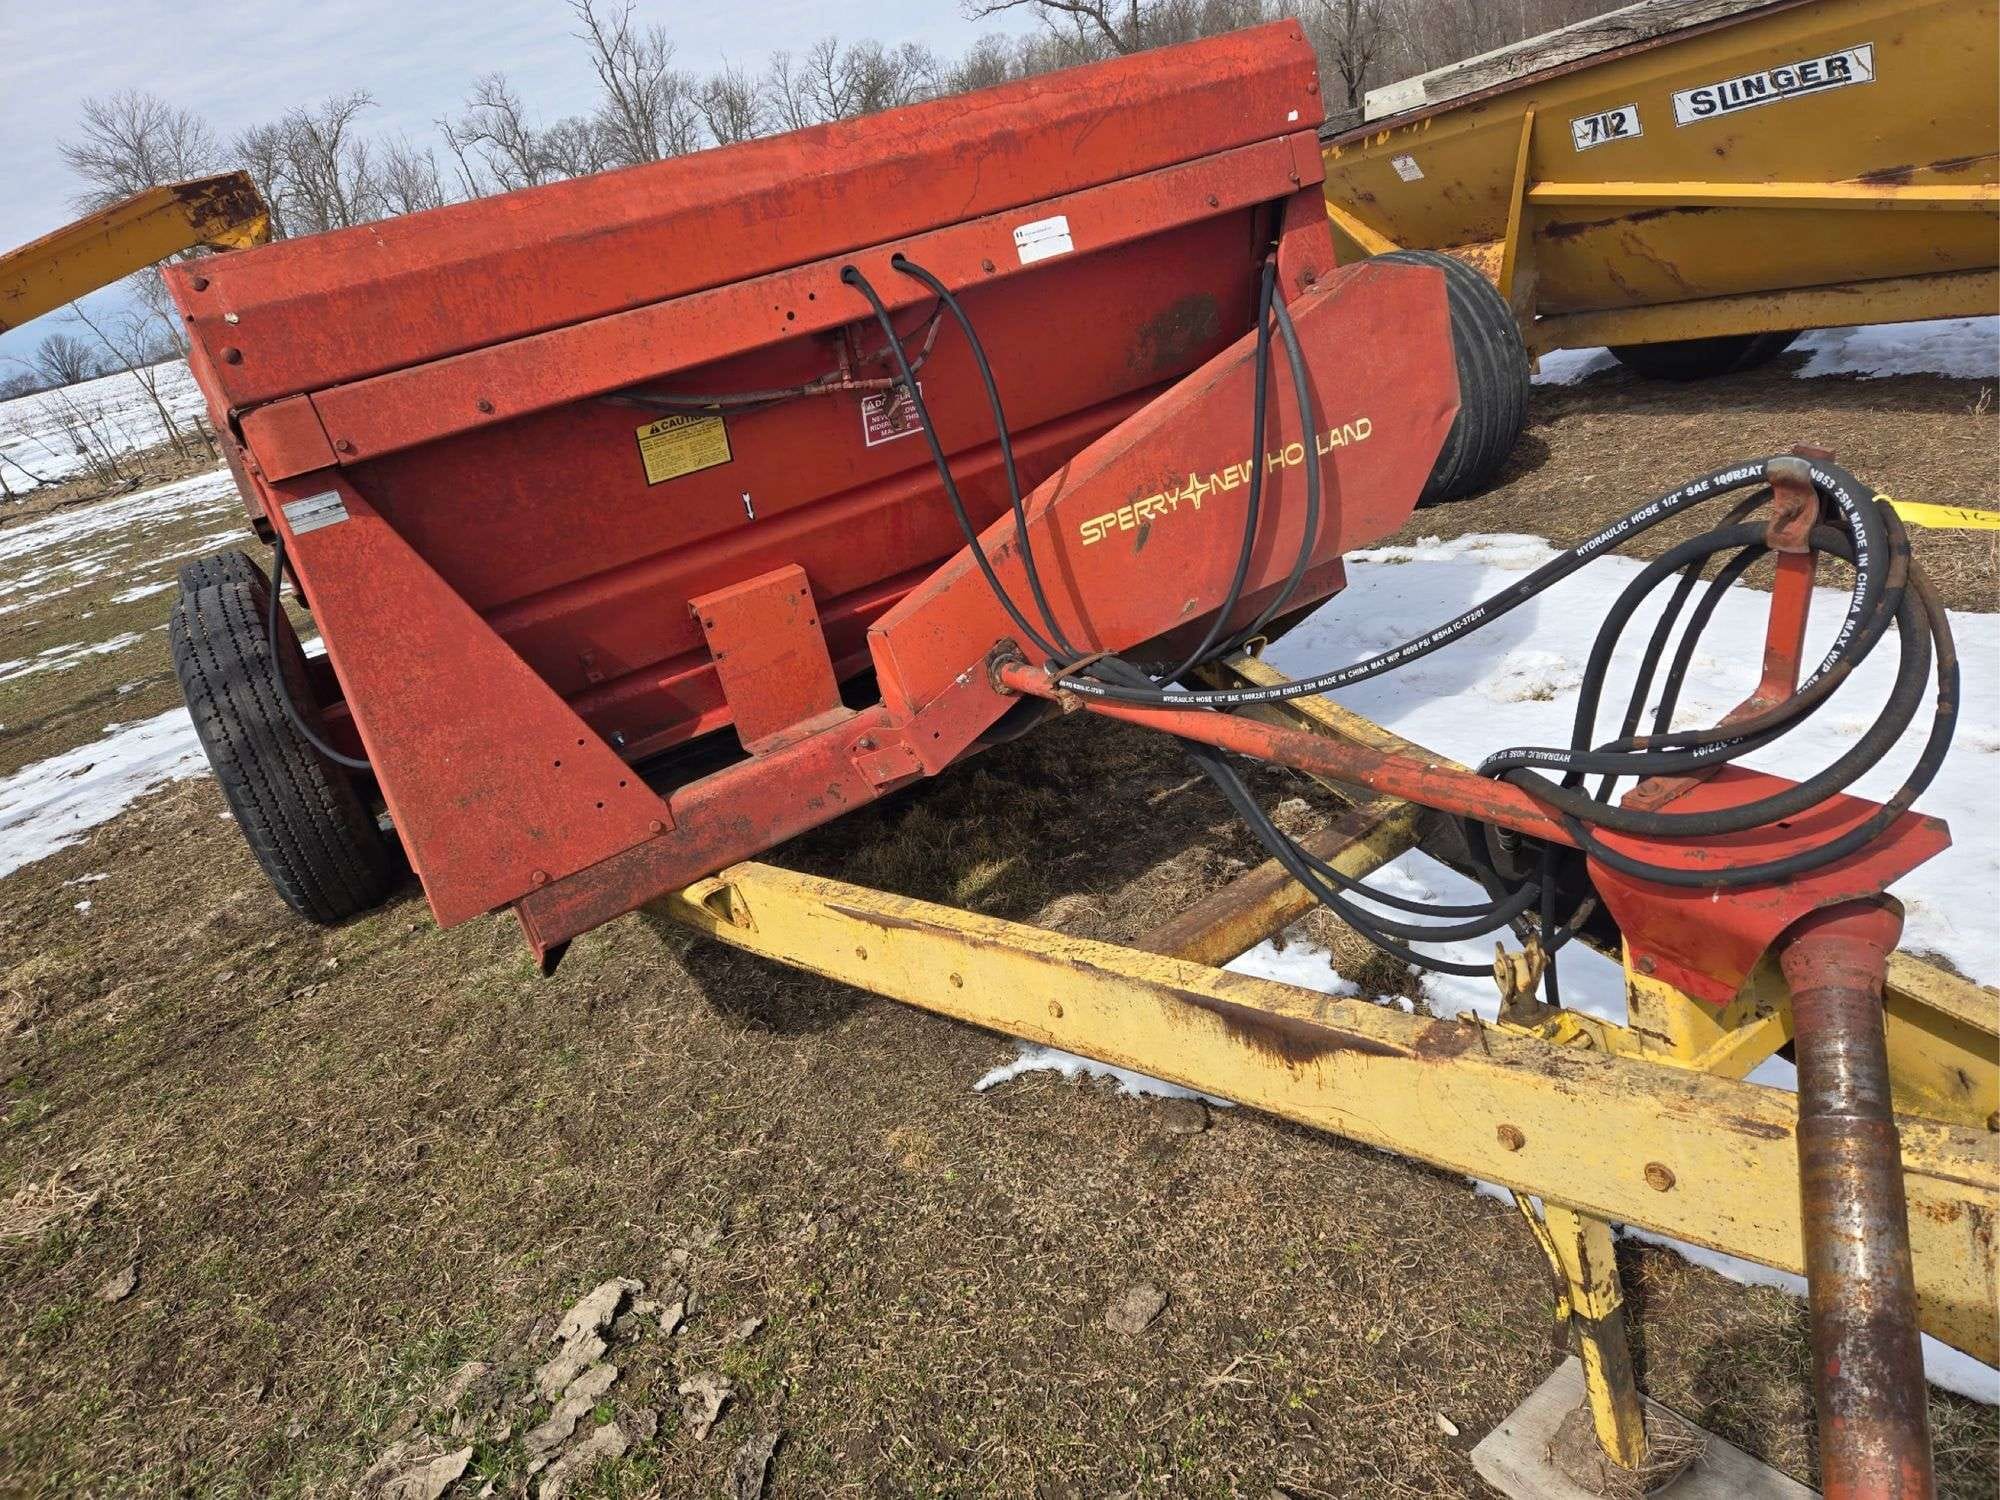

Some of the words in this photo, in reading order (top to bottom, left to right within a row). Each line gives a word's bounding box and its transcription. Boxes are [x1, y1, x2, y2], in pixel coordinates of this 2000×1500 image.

[1690, 55, 1852, 115] SLINGER
[1584, 111, 1629, 143] 712
[660, 415, 707, 431] CAUTIO
[1080, 487, 1180, 546] SPERRY
[1267, 418, 1373, 474] HOLAND
[1713, 464, 1764, 486] 100R2AT
[1662, 491, 1682, 508] 1/2"
[1685, 481, 1710, 498] SAE
[1834, 487, 1855, 511] 2SN
[1630, 504, 1660, 525] HOSE
[1576, 520, 1629, 557] HYDRAULIC
[1849, 511, 1868, 549] MADE
[1857, 552, 1869, 567] IN
[1850, 572, 1868, 614] CHINA
[1836, 619, 1857, 648] MAX
[1163, 695, 1194, 703] HYDRAULIC
[1227, 694, 1240, 702] SAE
[1318, 675, 1337, 687] MADE
[1338, 673, 1347, 681] IN
[1347, 665, 1369, 678] CHINA
[1370, 658, 1387, 670] MAX
[1418, 638, 1431, 650] PSI
[1432, 626, 1453, 642] MSHA
[1821, 650, 1841, 673] W/P
[1509, 750, 1526, 759] HOSE
[1528, 750, 1571, 763] HYDRAULIC
